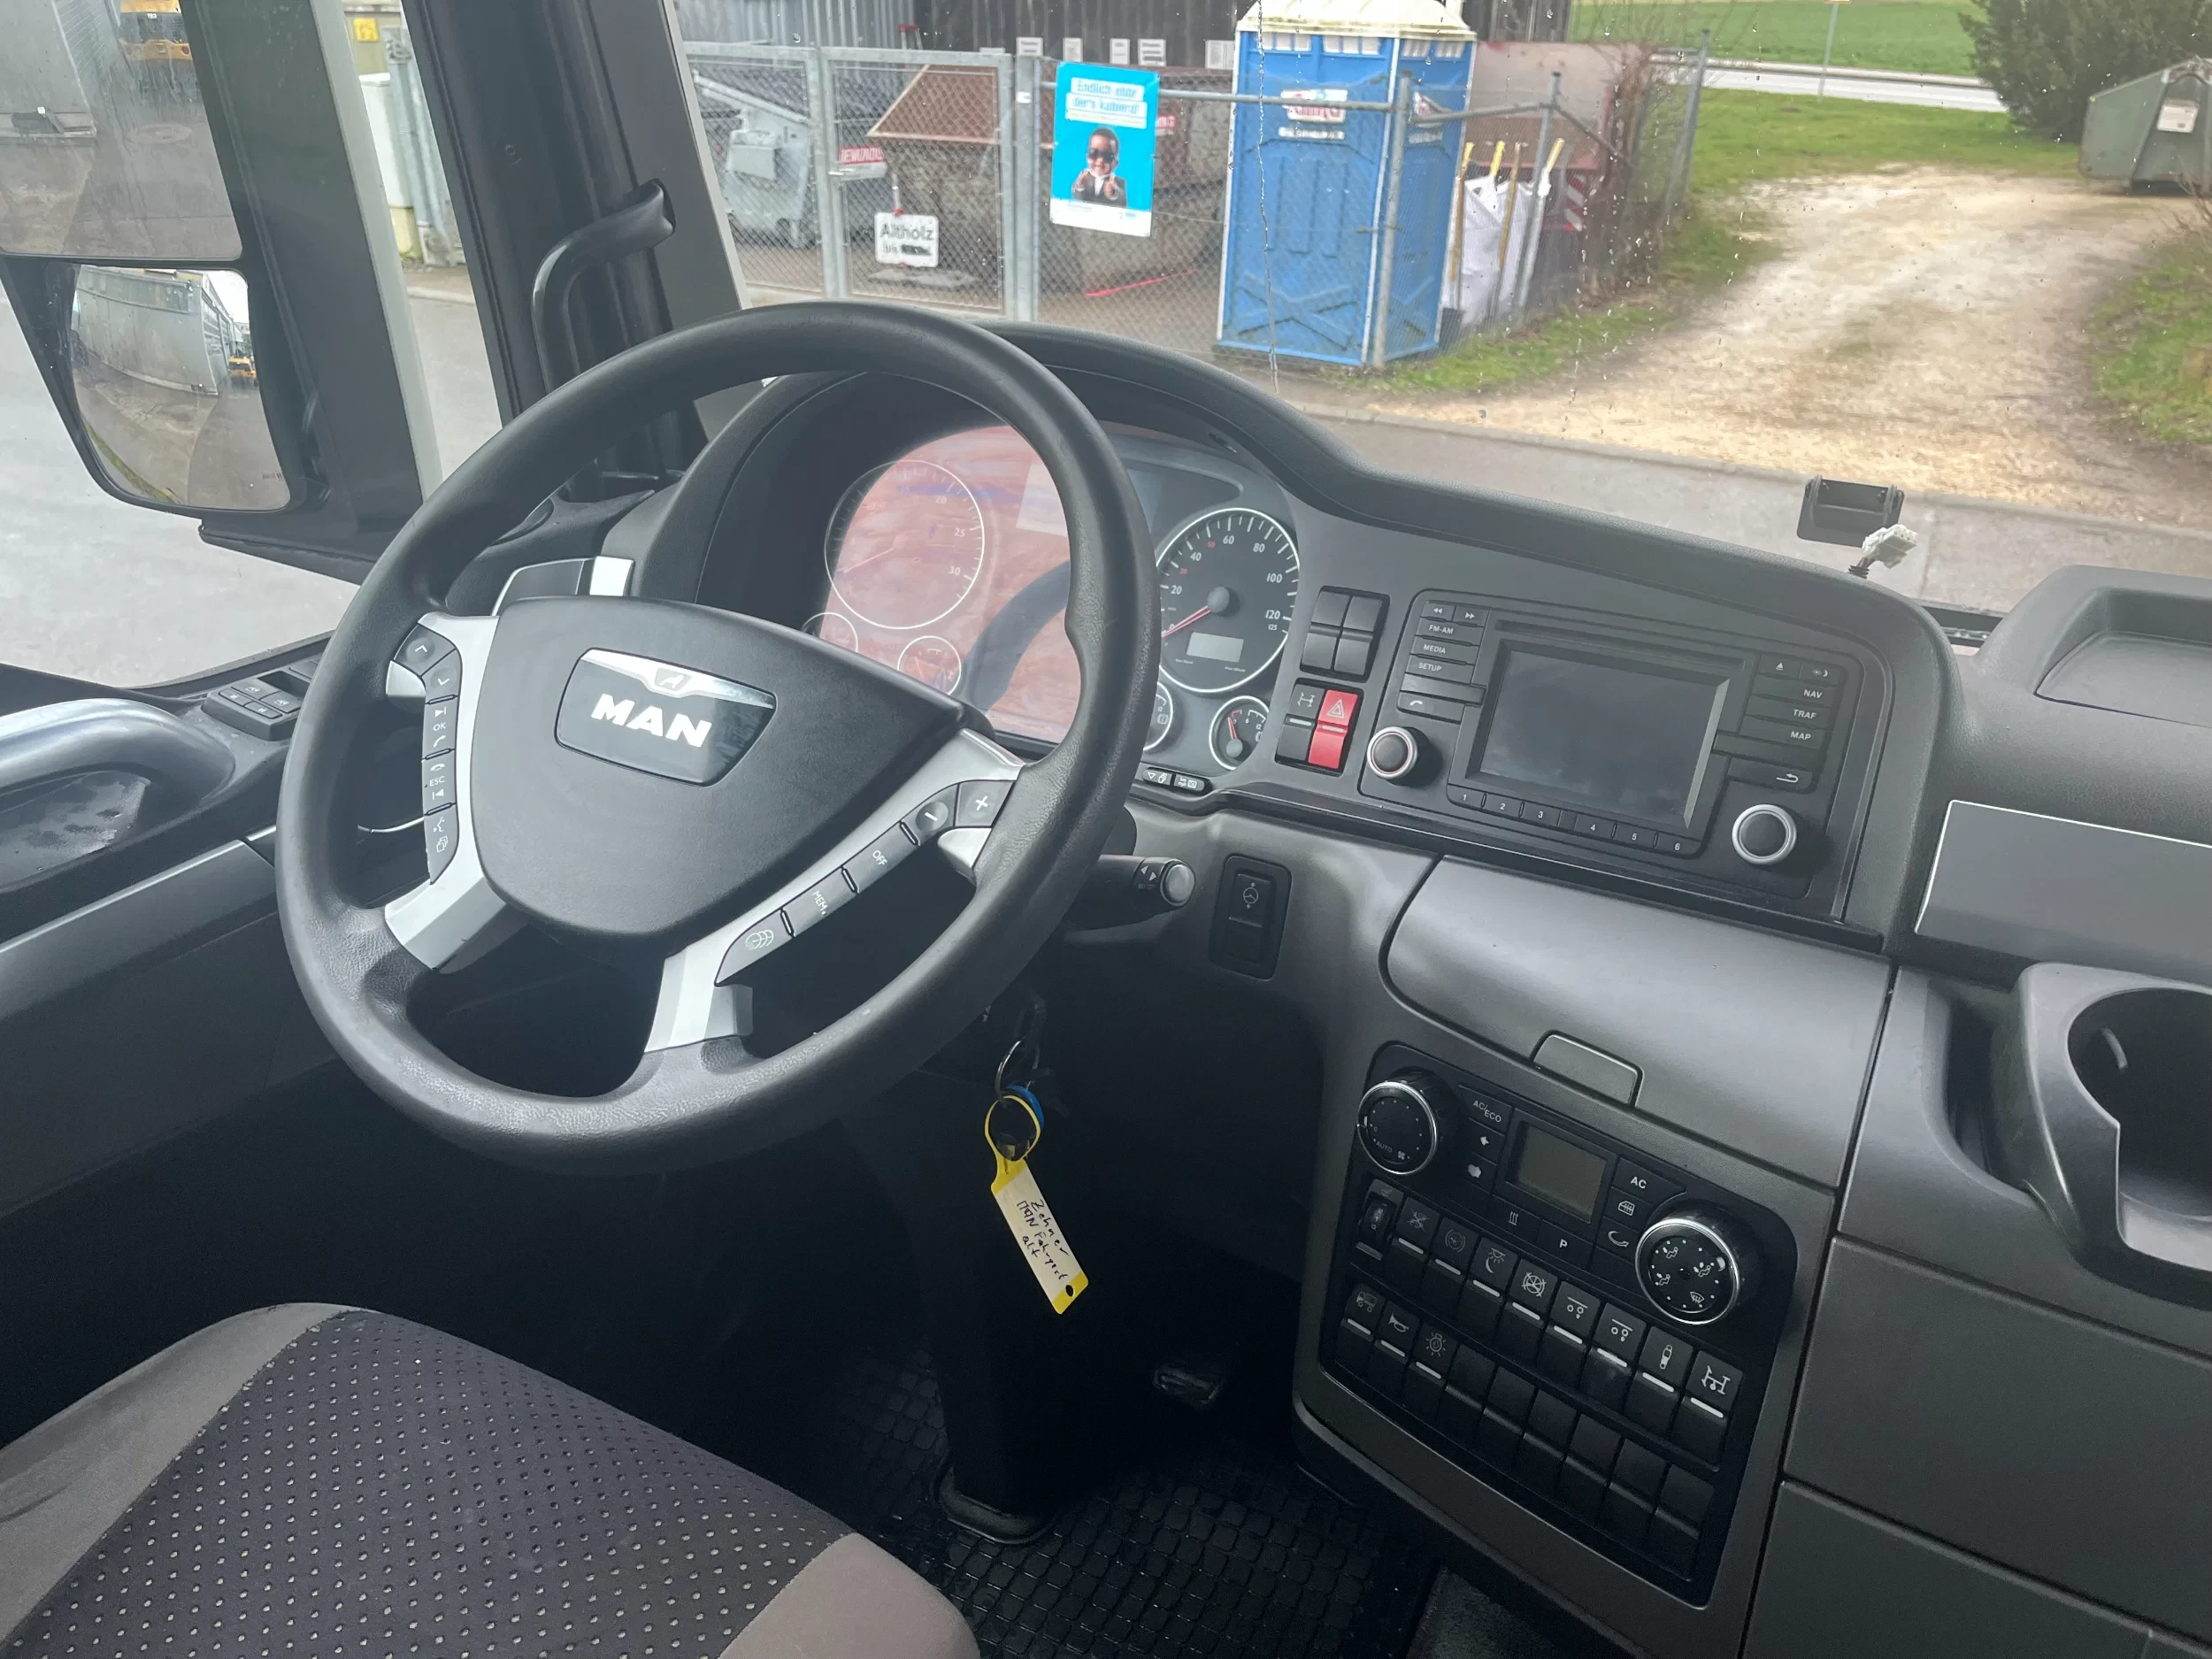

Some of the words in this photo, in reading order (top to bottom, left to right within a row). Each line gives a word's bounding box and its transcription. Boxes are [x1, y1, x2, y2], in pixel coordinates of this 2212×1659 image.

[954, 527, 966, 538] 25
[1223, 535, 1235, 545] 60
[1253, 542, 1265, 553] 80
[1190, 552, 1202, 562] 40
[949, 565, 961, 576] 30
[1266, 573, 1283, 584] 100
[1171, 585, 1182, 595] 20
[1265, 610, 1280, 619] 120
[1428, 624, 1454, 634] FM-AM
[1423, 643, 1446, 654] MEDIA
[1418, 662, 1442, 672] SETUP
[1803, 689, 1823, 699] NAV
[1793, 709, 1816, 719] TRAF
[591, 693, 711, 748] MAN
[433, 722, 446, 732] OK
[1790, 731, 1811, 741] MAP
[429, 776, 445, 787] ESC
[1674, 842, 1680, 851] 6
[872, 849, 887, 866] OFF
[1376, 1141, 1393, 1153] AUTO
[1630, 1176, 1647, 1188] AC
[1559, 1239, 1568, 1248] P
